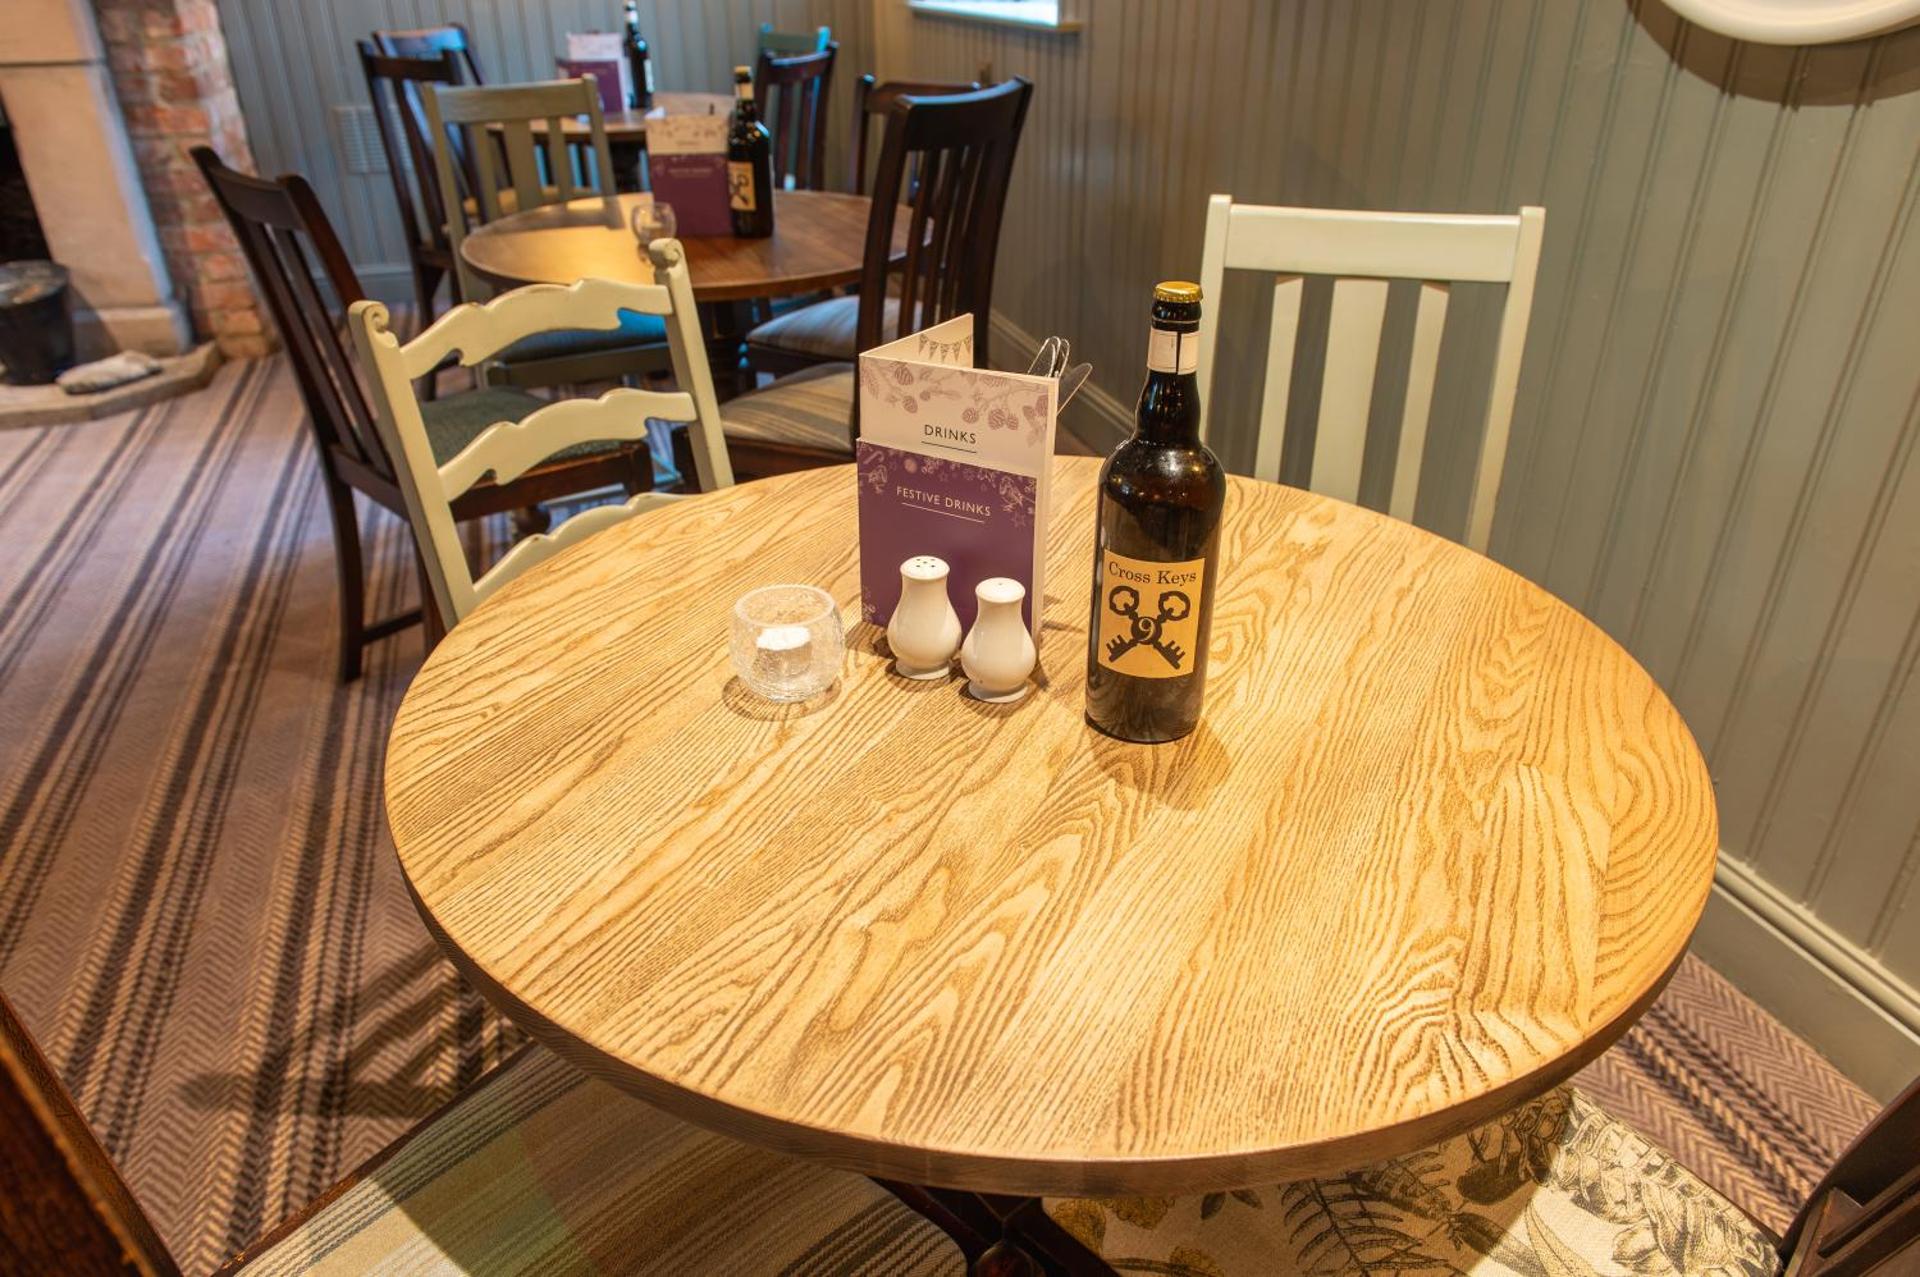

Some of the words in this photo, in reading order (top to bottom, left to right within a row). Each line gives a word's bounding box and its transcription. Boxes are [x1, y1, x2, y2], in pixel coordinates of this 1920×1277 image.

[924, 424, 977, 444] DRINKS
[896, 485, 941, 506] FESTIVE
[945, 497, 992, 517] DRINKS
[1109, 561, 1151, 583] Cross
[1156, 570, 1197, 587] Keys
[1138, 618, 1155, 641] 9
